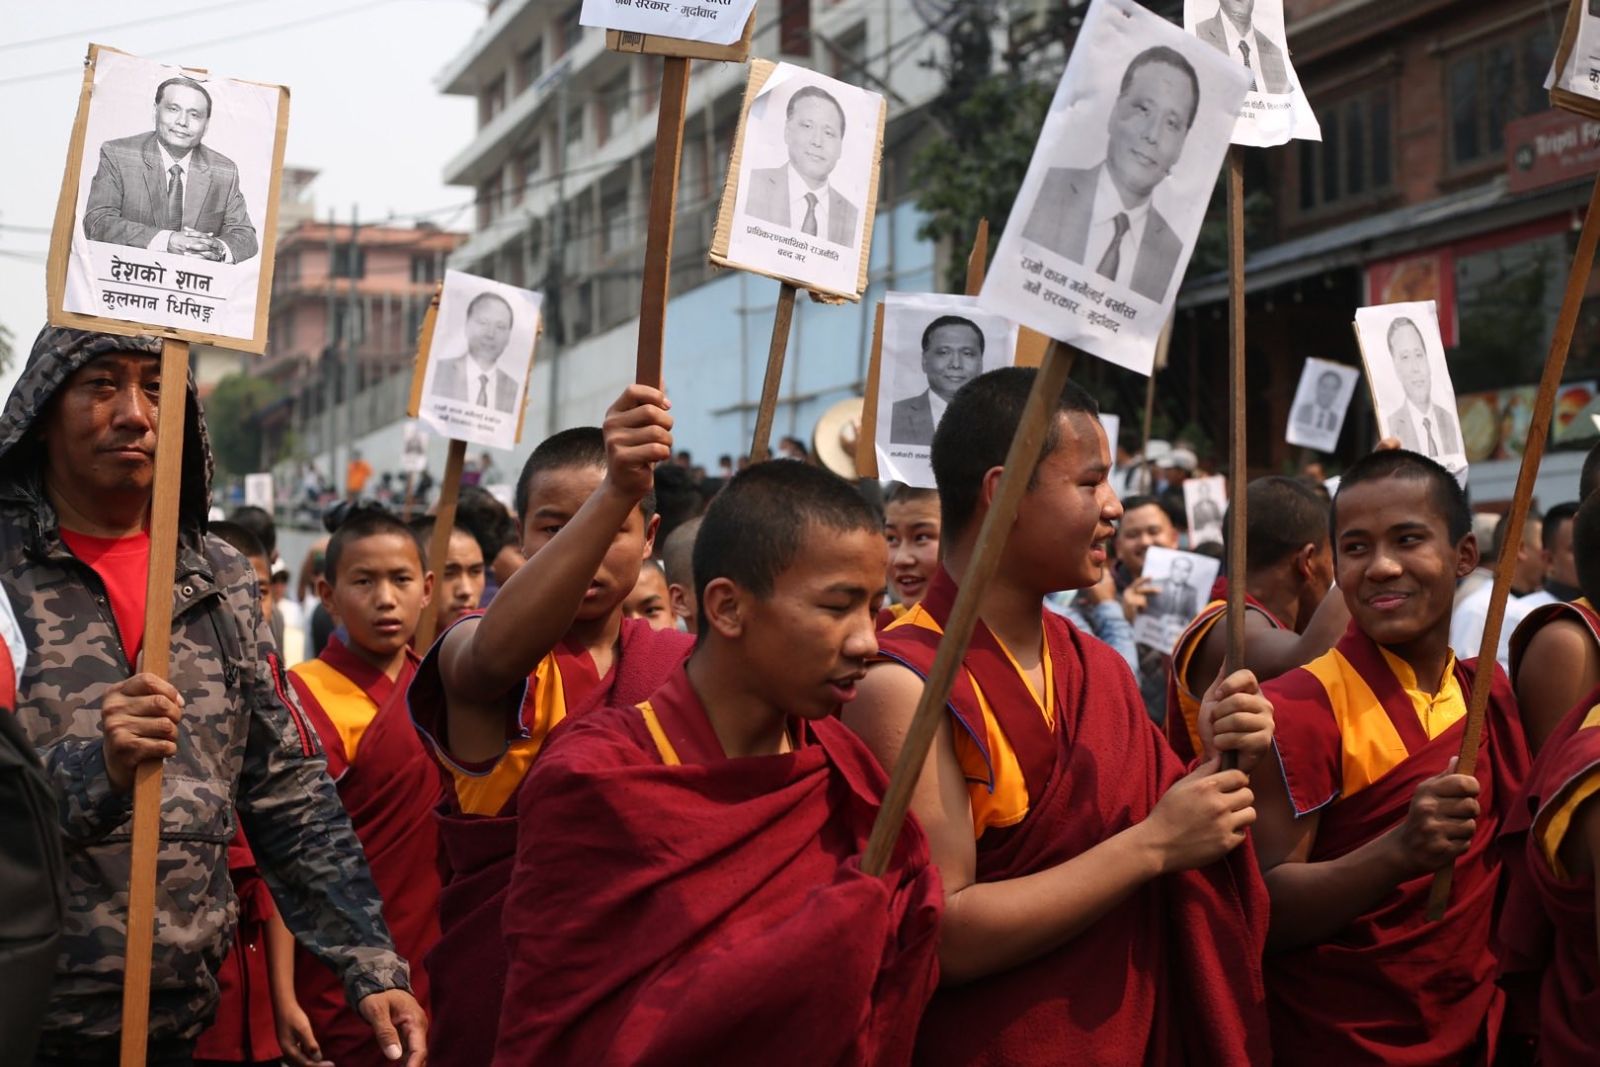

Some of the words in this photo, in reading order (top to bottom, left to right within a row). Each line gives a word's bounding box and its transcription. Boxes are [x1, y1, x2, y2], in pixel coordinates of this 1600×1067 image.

[110, 254, 167, 284] देशको
[175, 269, 213, 292] शान
[102, 289, 160, 311] कुलमान
